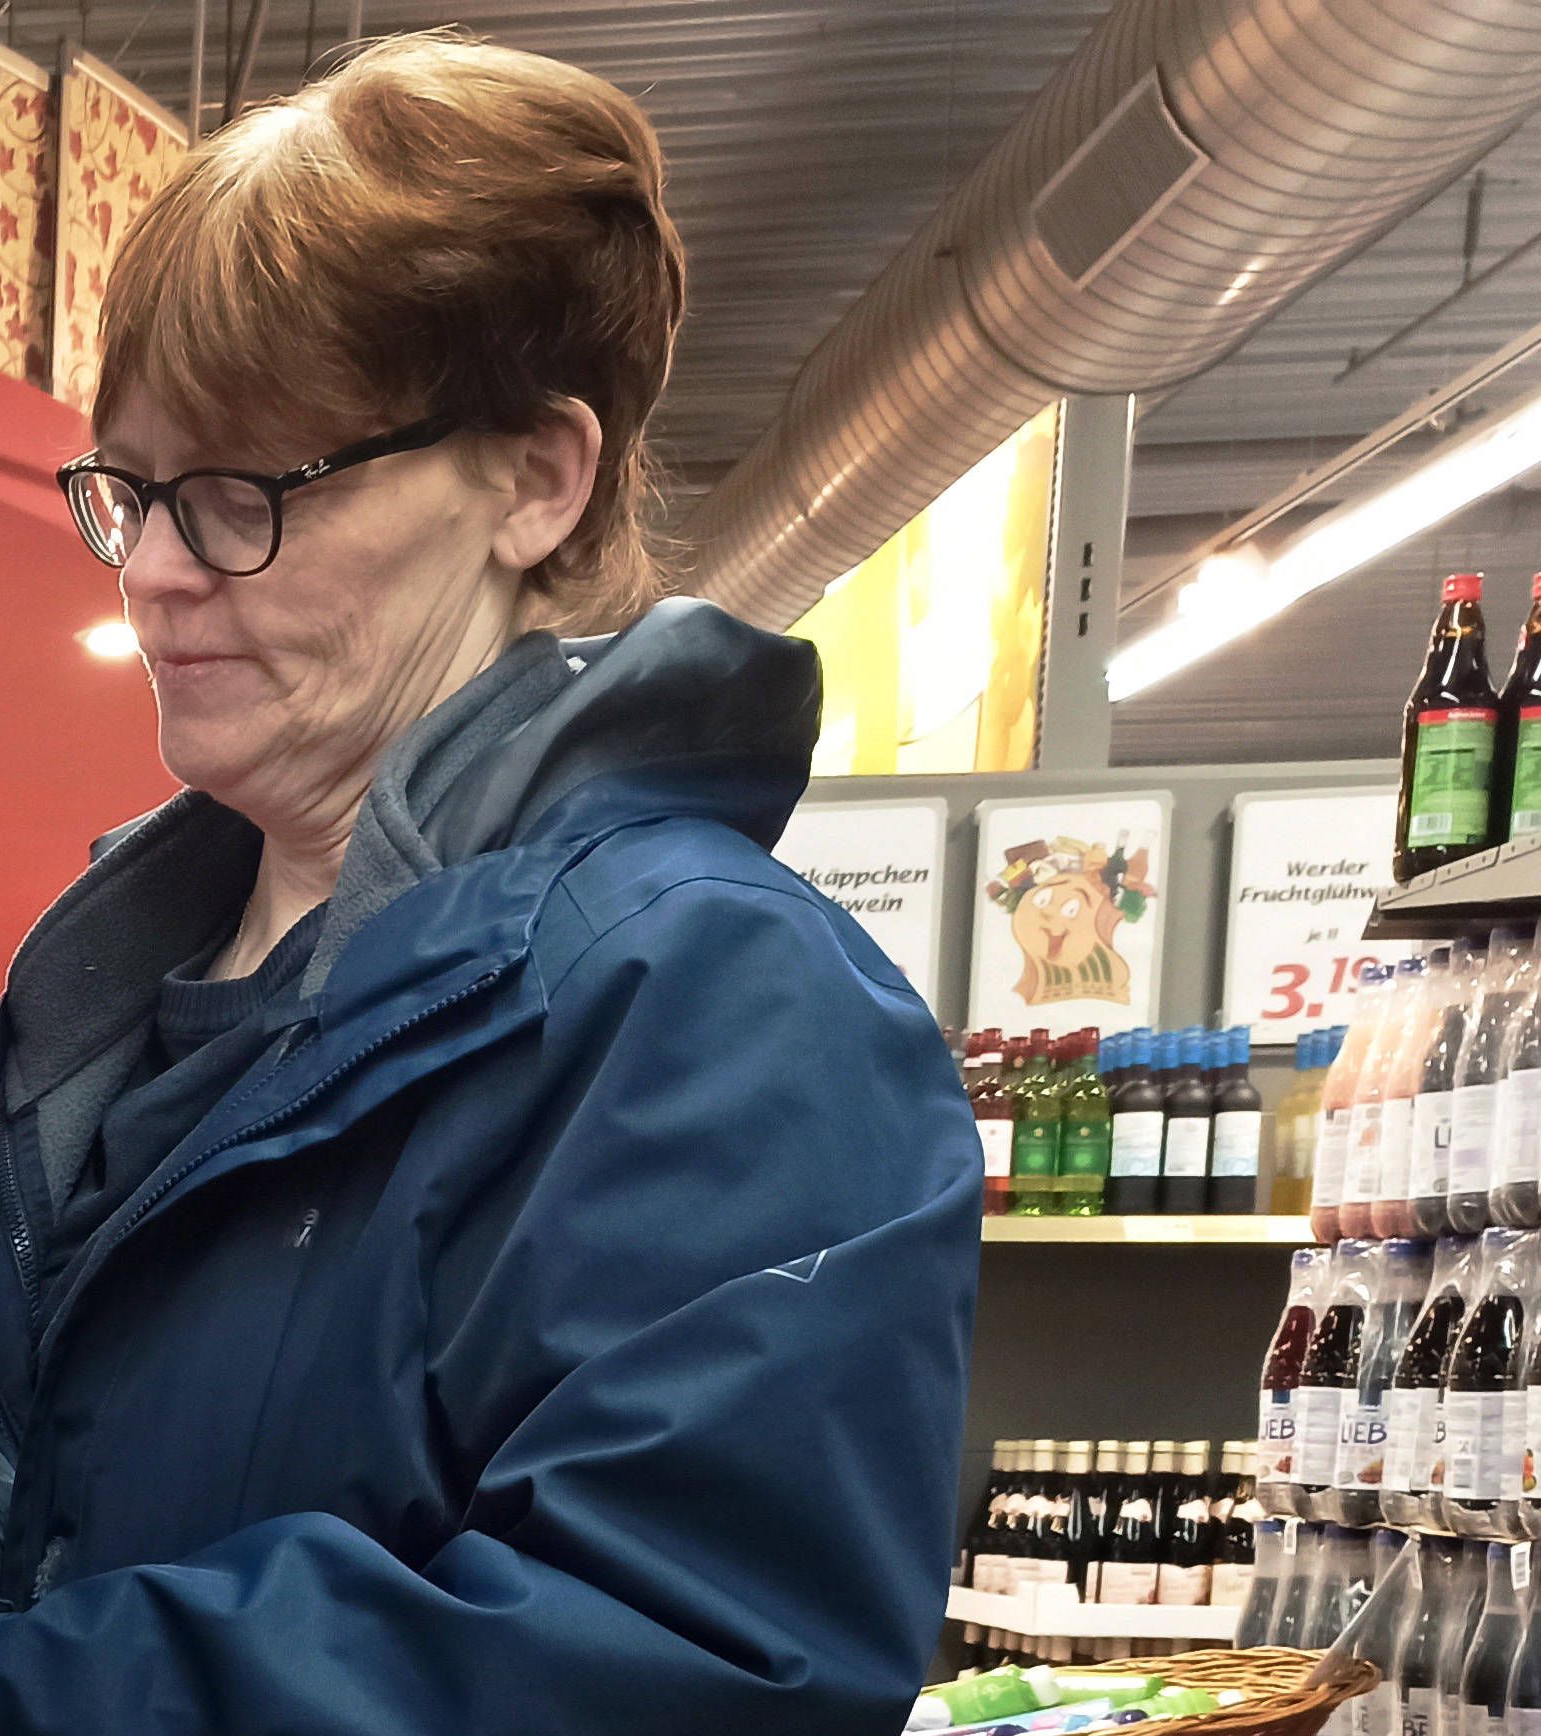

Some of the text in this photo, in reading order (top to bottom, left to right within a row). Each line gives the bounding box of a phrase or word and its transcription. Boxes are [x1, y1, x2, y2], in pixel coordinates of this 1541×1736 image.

[800, 864, 929, 890] käppchen
[1287, 859, 1370, 878] Werder
[1238, 883, 1375, 905] Fruchtglühw
[1305, 929, 1321, 944] je
